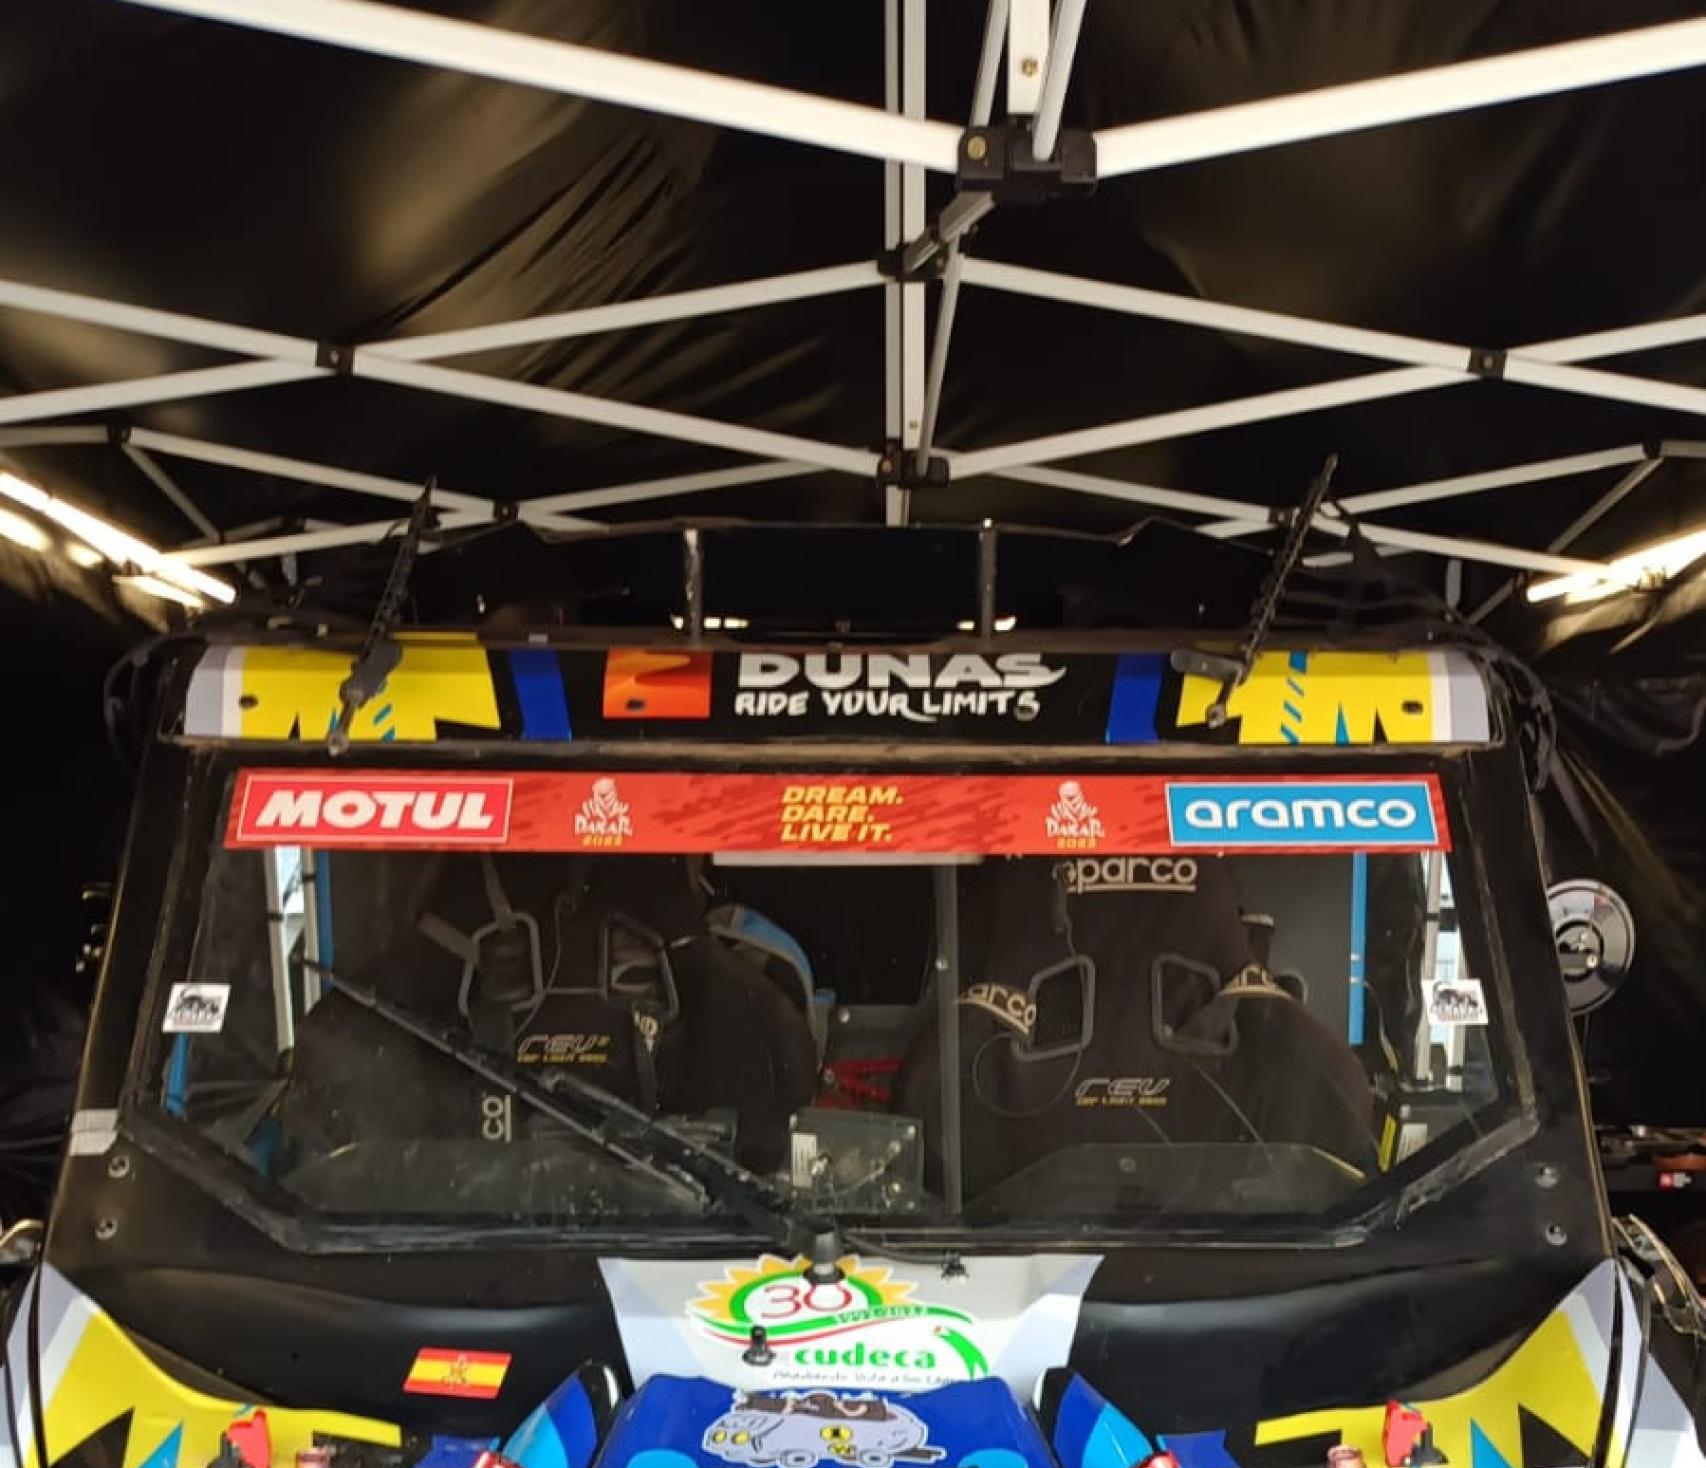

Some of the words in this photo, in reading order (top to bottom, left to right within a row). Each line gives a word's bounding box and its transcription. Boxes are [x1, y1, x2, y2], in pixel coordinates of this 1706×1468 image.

[737, 652, 1067, 689] DUNAS
[734, 690, 809, 717] RIDE
[922, 690, 1041, 722] LIMITS
[255, 788, 496, 831] MOTUL
[780, 785, 904, 805] DREAM.
[780, 804, 875, 823] DARE.
[1185, 798, 1418, 829] aramco
[780, 822, 850, 842] LIVE
[856, 822, 894, 842] IT.
[794, 1342, 937, 1369] cudeca
